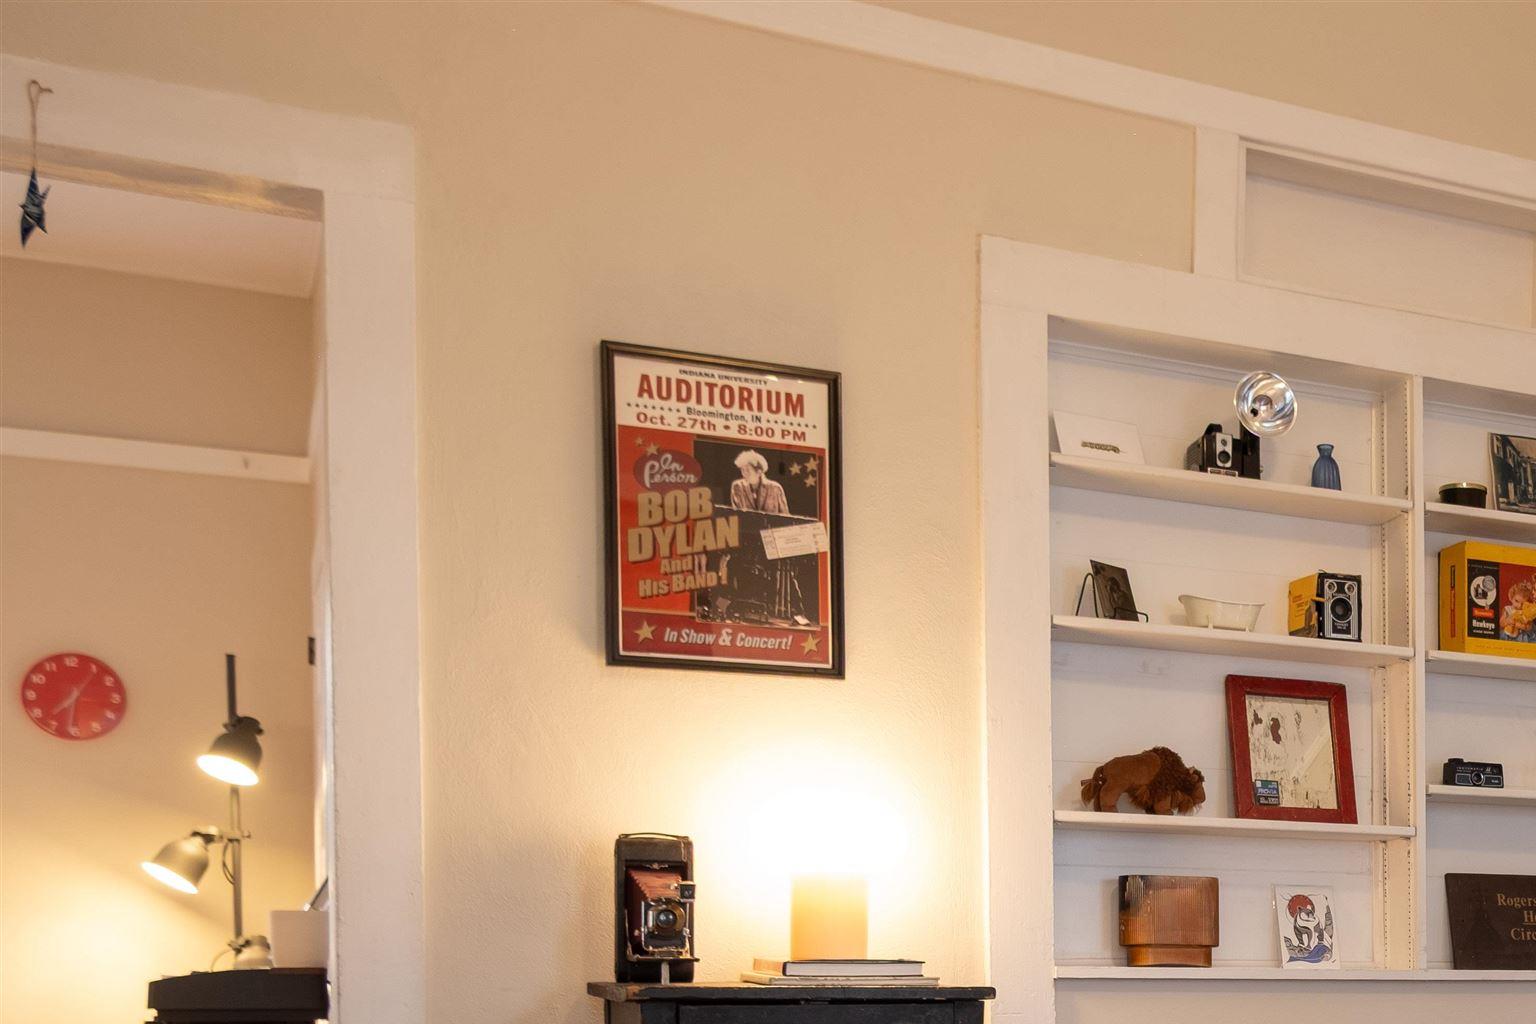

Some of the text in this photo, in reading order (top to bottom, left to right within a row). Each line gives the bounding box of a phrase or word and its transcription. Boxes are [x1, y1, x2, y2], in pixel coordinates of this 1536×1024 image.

[679, 369, 768, 385] INDIANA UNIVERSITY
[637, 373, 805, 418] AUDITORIUM
[636, 412, 807, 442] Oct. 27th 8:00 PM
[686, 406, 762, 424] Bloomington, IN
[643, 460, 698, 488] Person
[637, 486, 713, 528] BOB
[627, 515, 740, 563] DYLAN
[663, 627, 793, 651] In Show & Concert!
